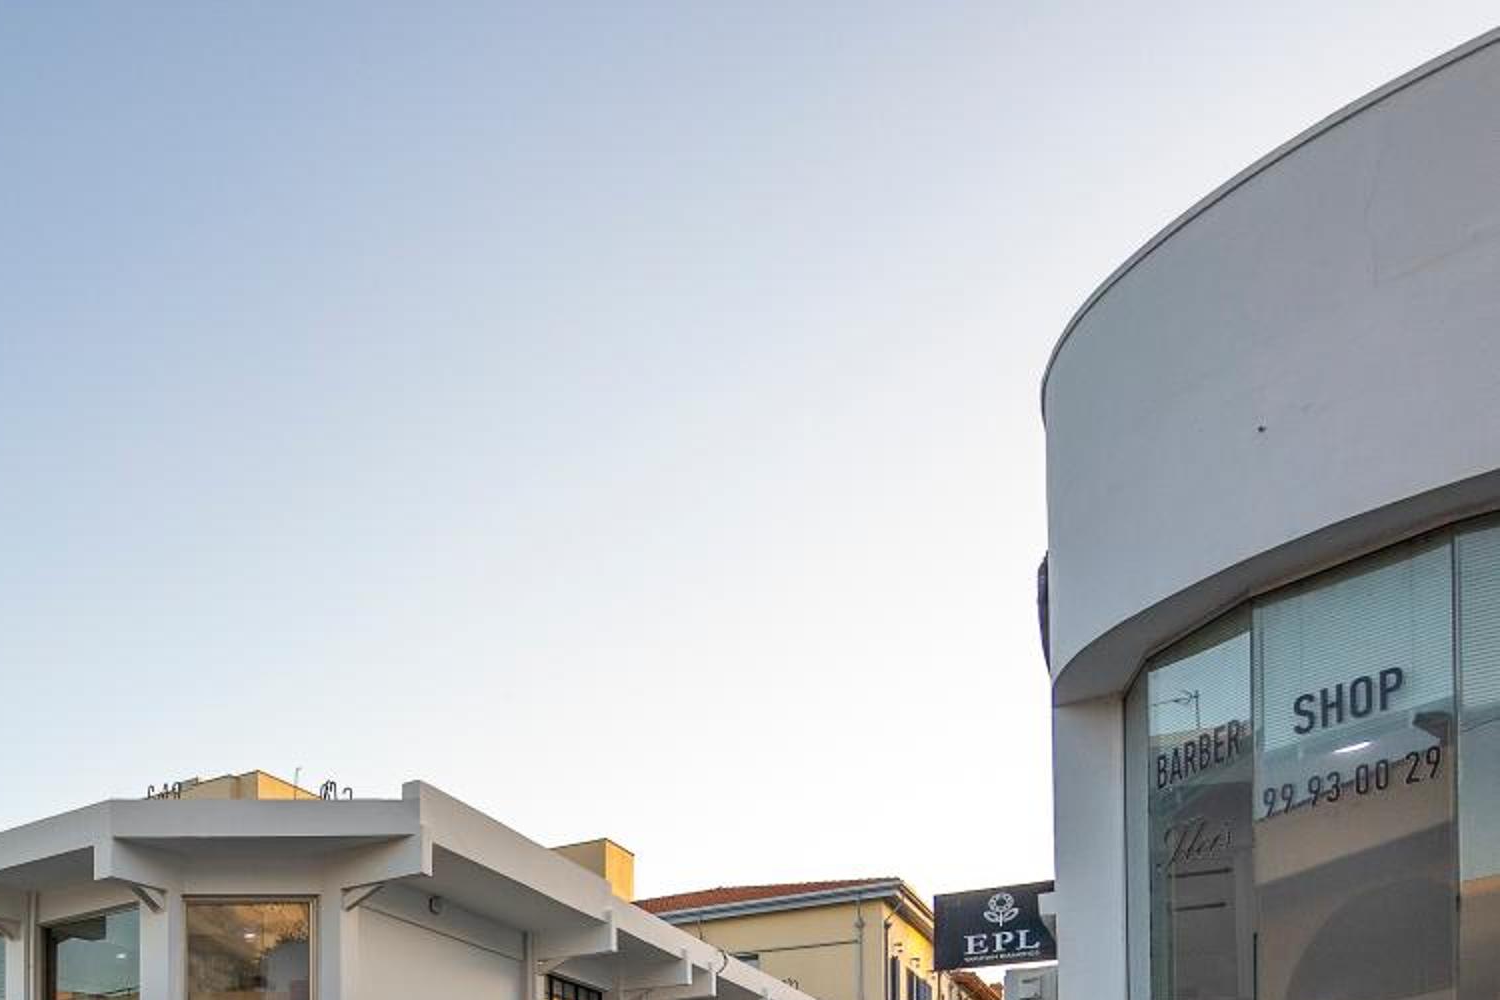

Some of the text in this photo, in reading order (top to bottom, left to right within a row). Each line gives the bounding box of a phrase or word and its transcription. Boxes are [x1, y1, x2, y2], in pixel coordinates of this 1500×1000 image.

[1156, 666, 1404, 790] BARBER SHOP
[1263, 745, 1442, 818] 99 93 00 29
[963, 929, 1041, 955] EPL
